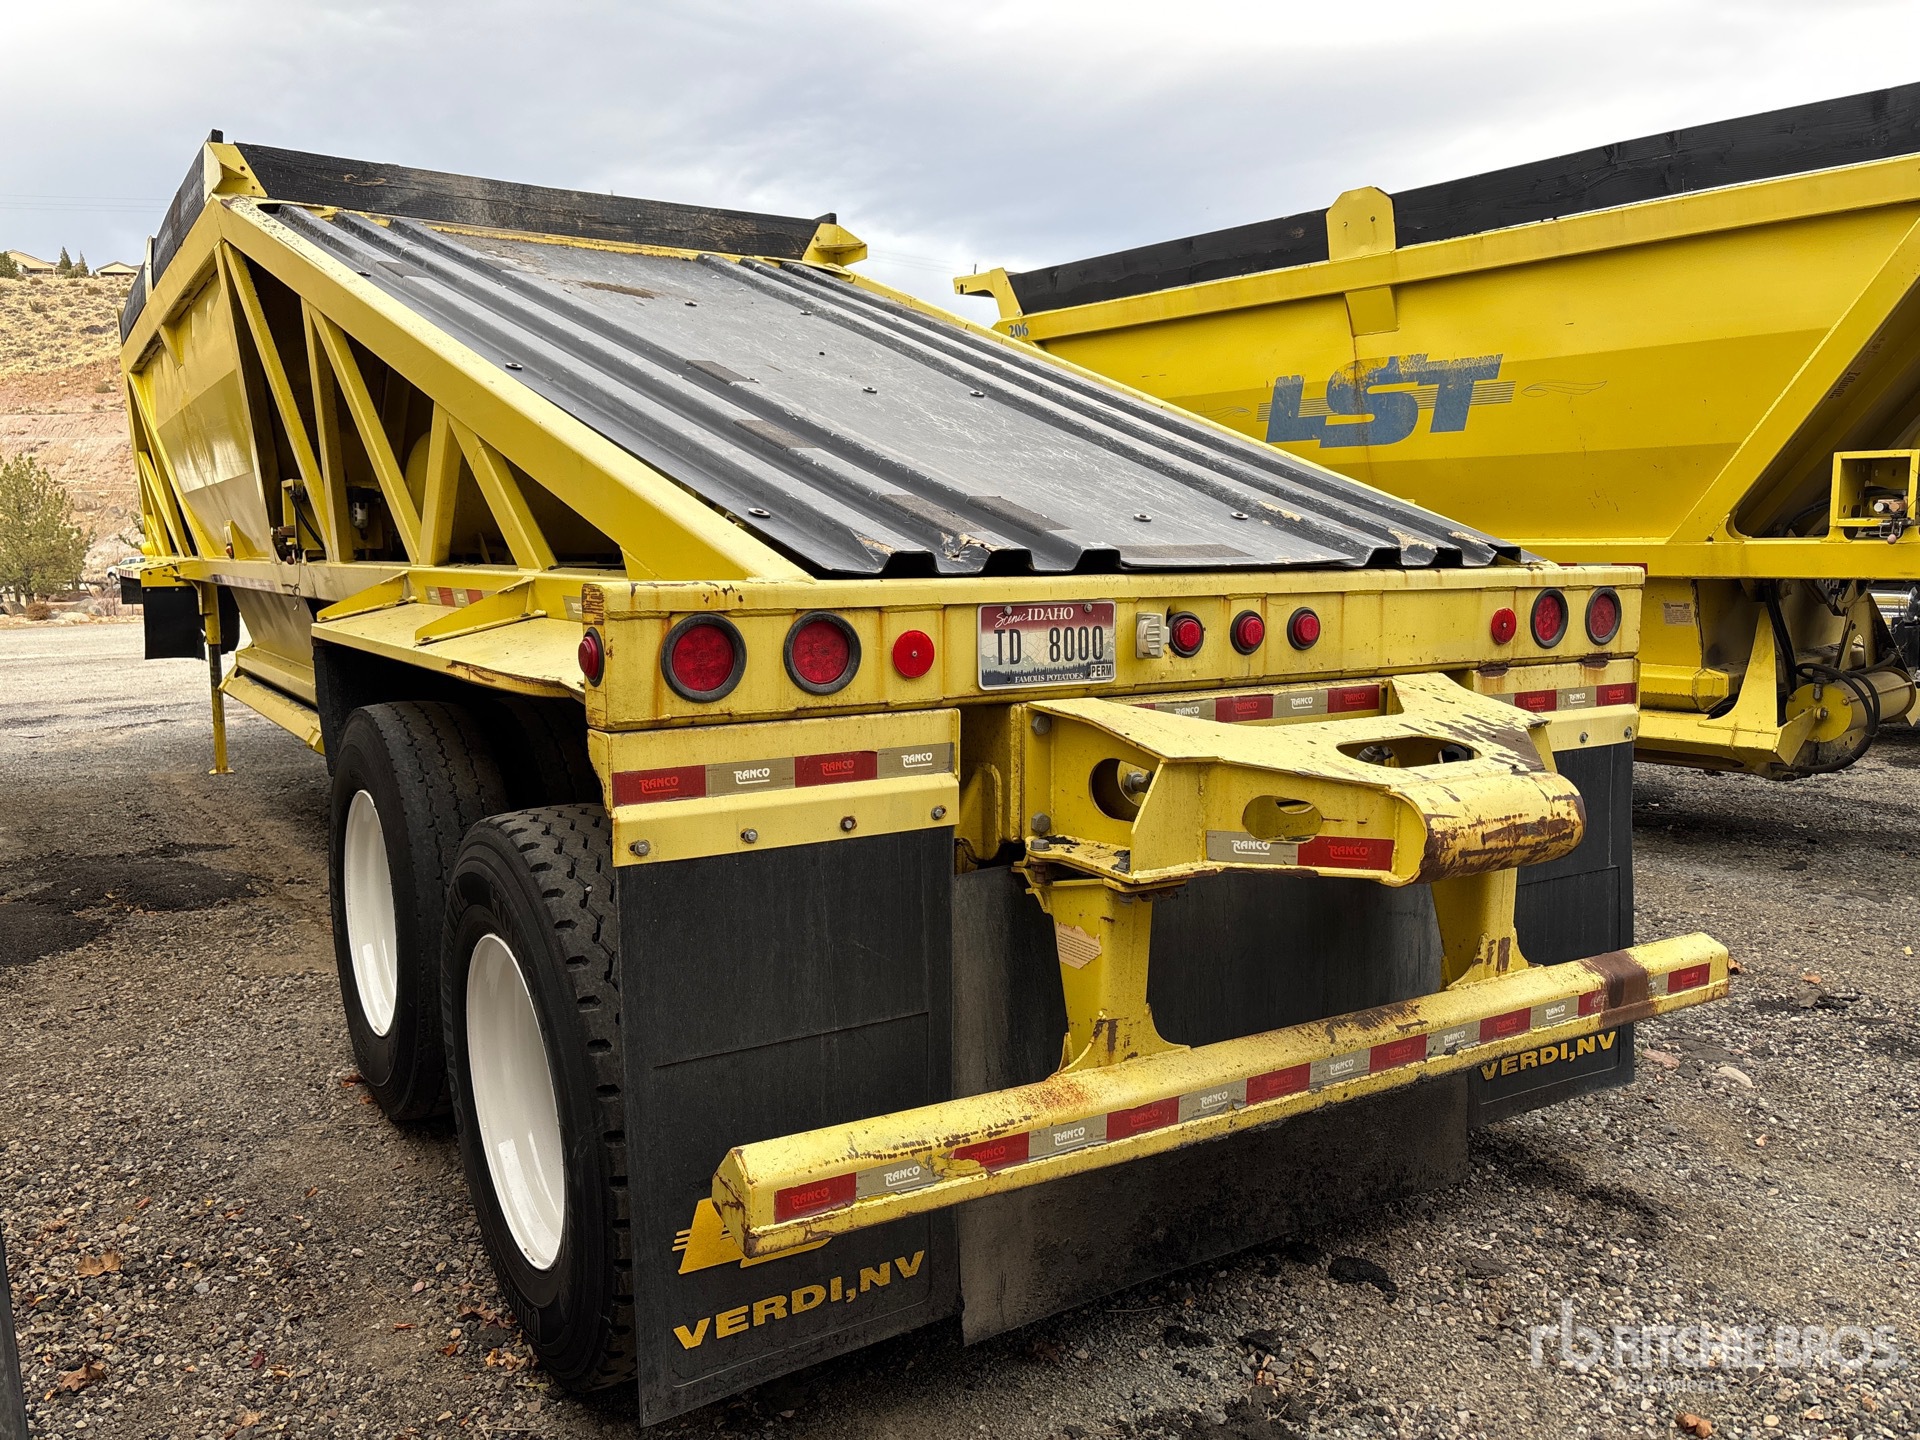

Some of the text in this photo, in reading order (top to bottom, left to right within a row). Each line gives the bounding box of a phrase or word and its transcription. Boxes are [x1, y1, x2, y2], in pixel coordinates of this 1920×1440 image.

[1008, 322, 1029, 338] 206
[1266, 353, 1504, 448] LST
[995, 607, 1074, 628] Scenic IDAHO
[994, 625, 1104, 665] TD 8000
[1014, 672, 1084, 683] FAMOUS POTATOES
[1091, 664, 1112, 677] PERM
[1234, 701, 1258, 714] RANCO
[1290, 696, 1314, 709] RANCO
[1174, 706, 1200, 718] RANCO
[820, 759, 855, 776] RANCO
[901, 752, 933, 768] RANCO
[733, 767, 770, 784] RANCO
[639, 776, 679, 794] RANCO
[1231, 839, 1271, 856] RANCO
[1328, 845, 1368, 861] RANCO
[1443, 1030, 1466, 1046] RANCO
[1480, 1031, 1617, 1081] VERDI,NV
[1329, 1059, 1354, 1075] RANCO
[1200, 1091, 1228, 1109] RANCO
[1053, 1126, 1085, 1146] RANCO
[971, 1145, 1006, 1165] RANCO
[884, 1165, 921, 1187] RANCO
[790, 1186, 831, 1210] RANCO
[673, 1250, 925, 1350] VERDI,NV
